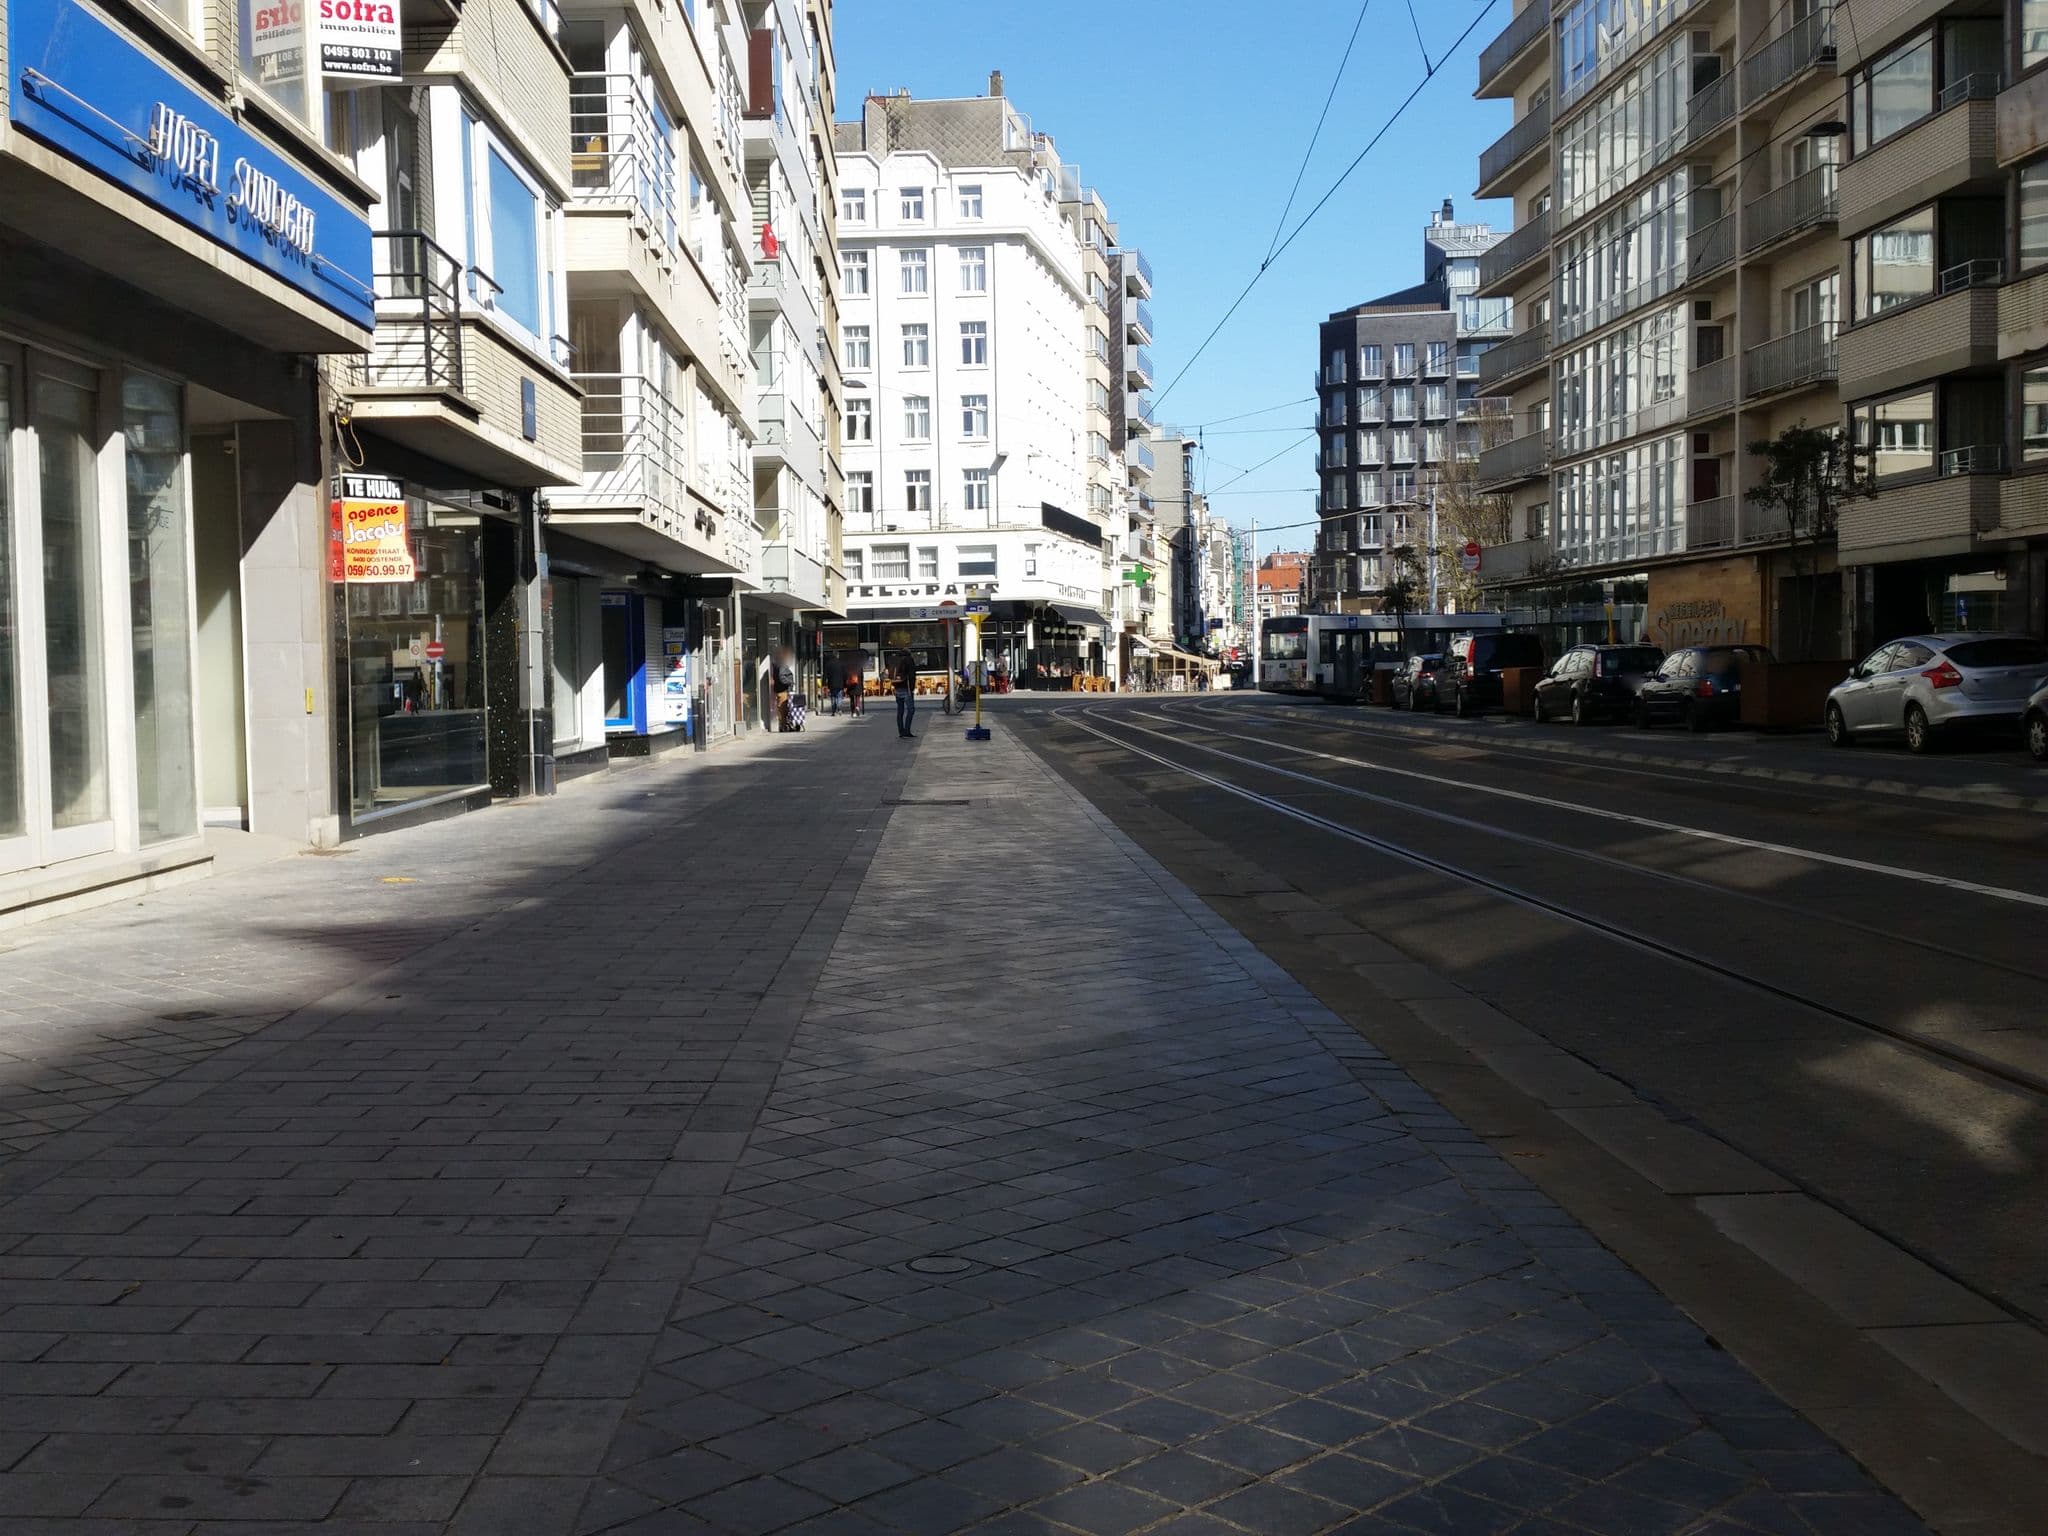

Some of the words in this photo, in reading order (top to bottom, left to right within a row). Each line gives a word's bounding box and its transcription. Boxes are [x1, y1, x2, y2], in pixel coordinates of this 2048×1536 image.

[320, 0, 394, 23] sofra
[320, 23, 396, 35] immobiliën
[324, 45, 350, 57] 0495
[352, 48, 371, 59] 801
[374, 50, 392, 61] 101
[324, 61, 393, 73] www.sofra.be
[149, 102, 220, 195] HOTEL
[347, 479, 364, 497] TE
[366, 480, 401, 499] HUUR
[348, 505, 399, 522] agence
[346, 520, 404, 544] Jacobs
[347, 564, 411, 576] 059/50.99.97
